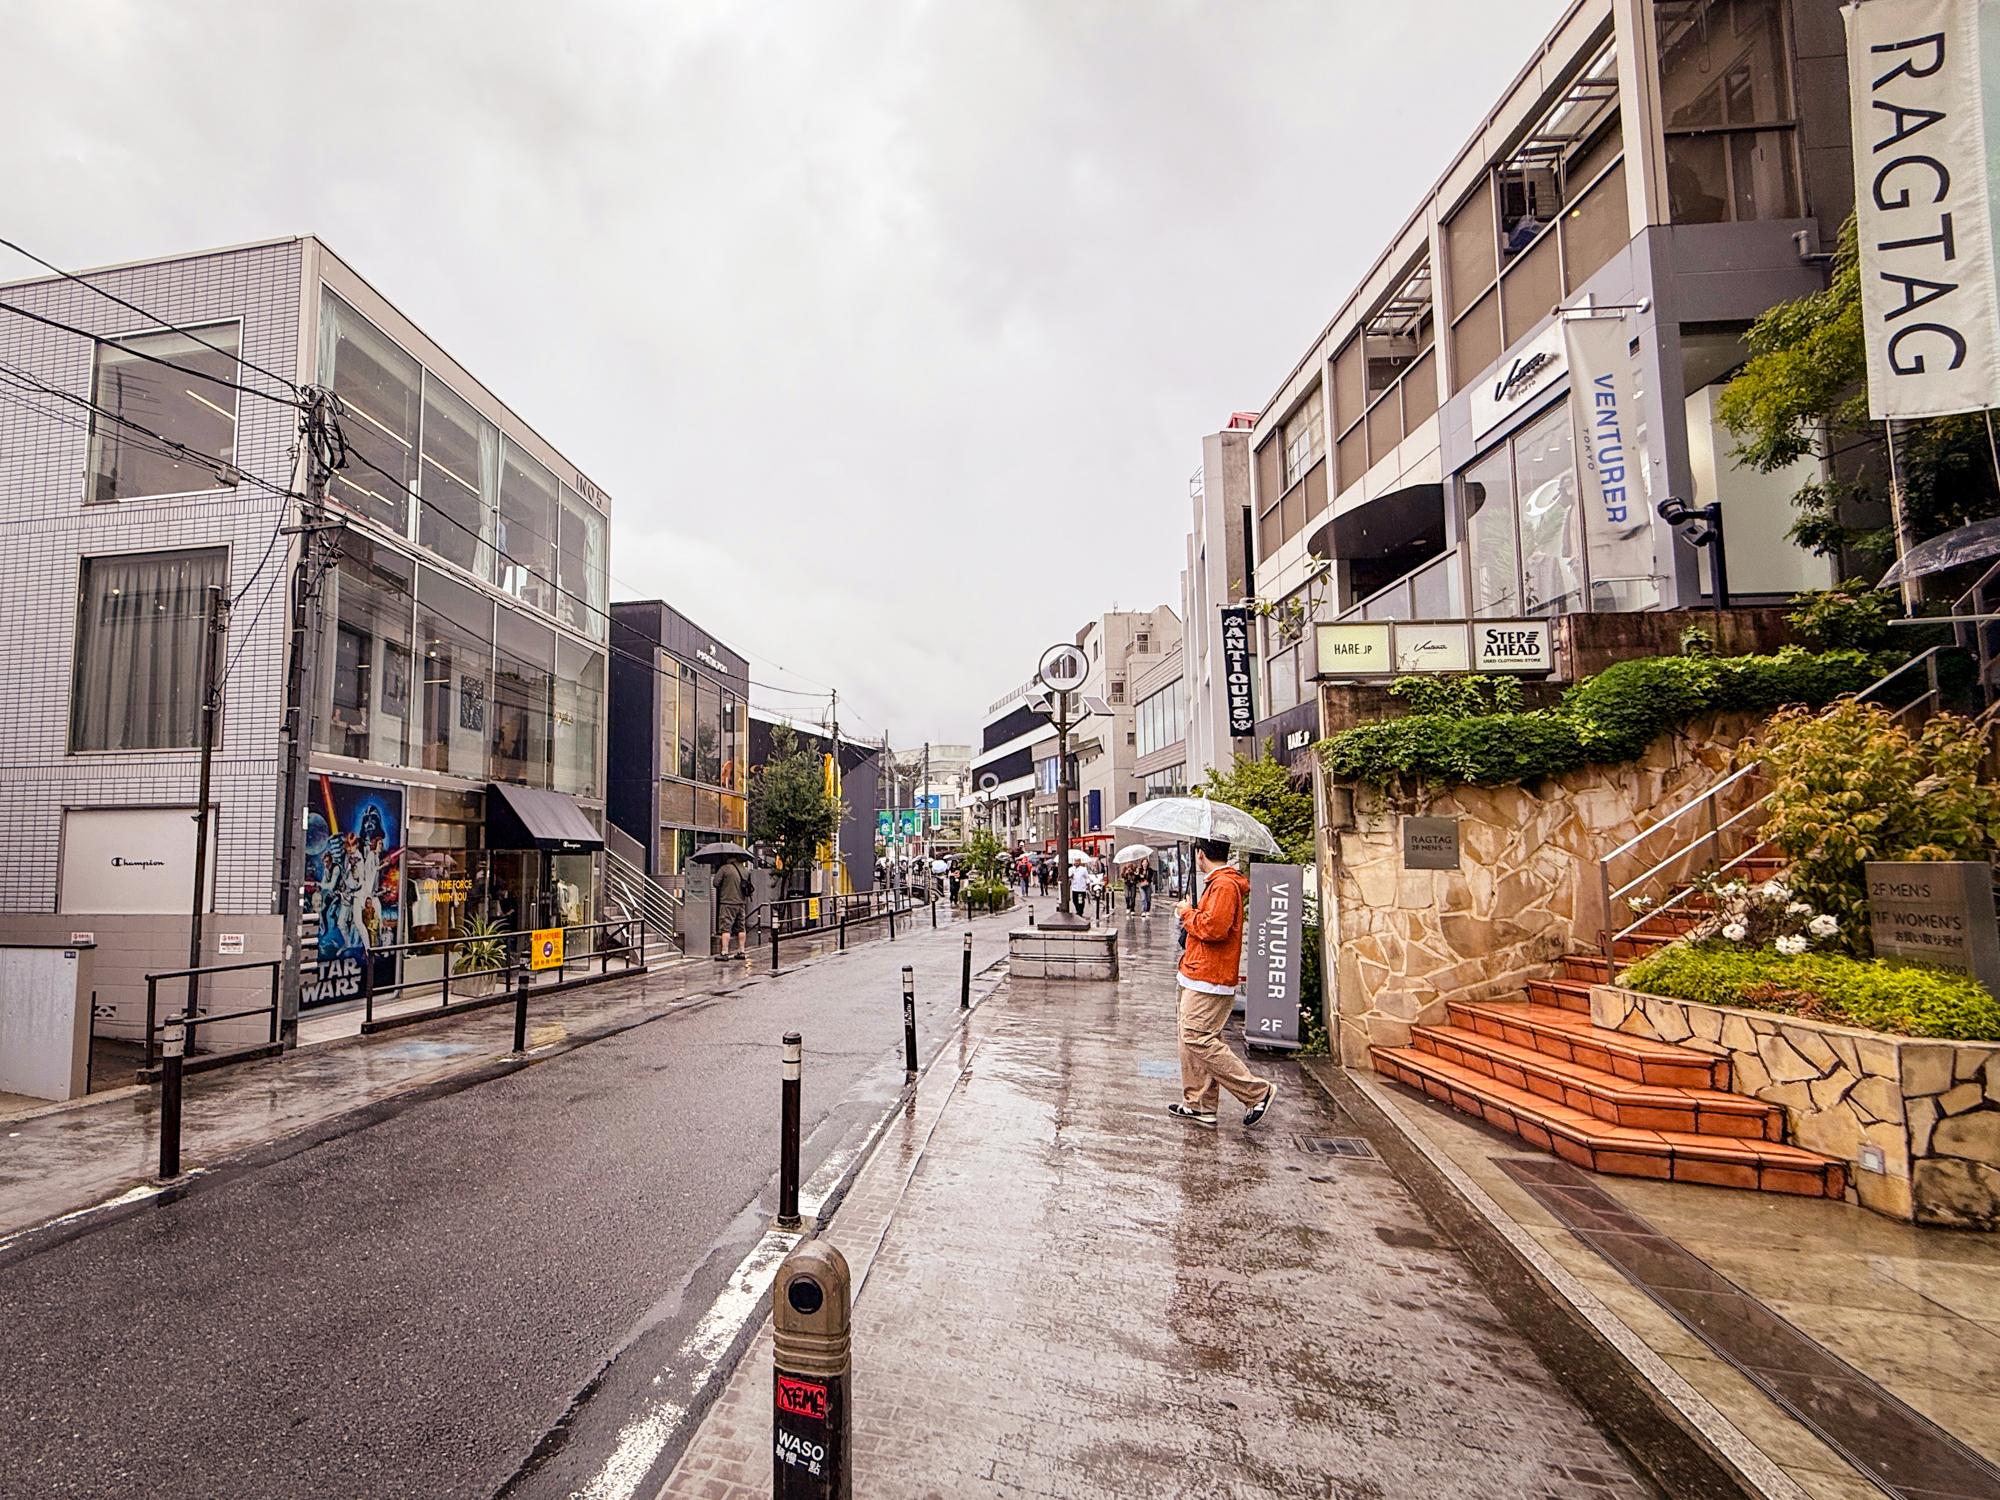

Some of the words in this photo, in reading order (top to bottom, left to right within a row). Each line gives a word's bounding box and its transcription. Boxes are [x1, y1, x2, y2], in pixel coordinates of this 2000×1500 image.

[1871, 32, 1966, 375] RAGTAG
[1583, 428, 1595, 470] TOKYO
[1594, 374, 1627, 523] VENTURER
[1486, 629, 1526, 644] STEP
[1483, 644, 1540, 656] AHEAD
[1225, 627, 1250, 719] ANTIQUES
[1411, 835, 1452, 844] RAGTAG
[111, 857, 165, 870] Champion
[441, 880, 452, 890] THE
[453, 880, 473, 889] FORCE
[1872, 883, 1886, 896] 2F
[1889, 884, 1931, 897] MEN'S
[1875, 911, 1888, 924] 1F
[1893, 913, 1962, 930] WOMEN'S
[1258, 922, 1266, 956] TOKYO
[1268, 883, 1289, 999] VENTURER
[301, 976, 361, 1003] WARS
[1260, 1018, 1283, 1032] 2F
[779, 1428, 824, 1461] WASO
